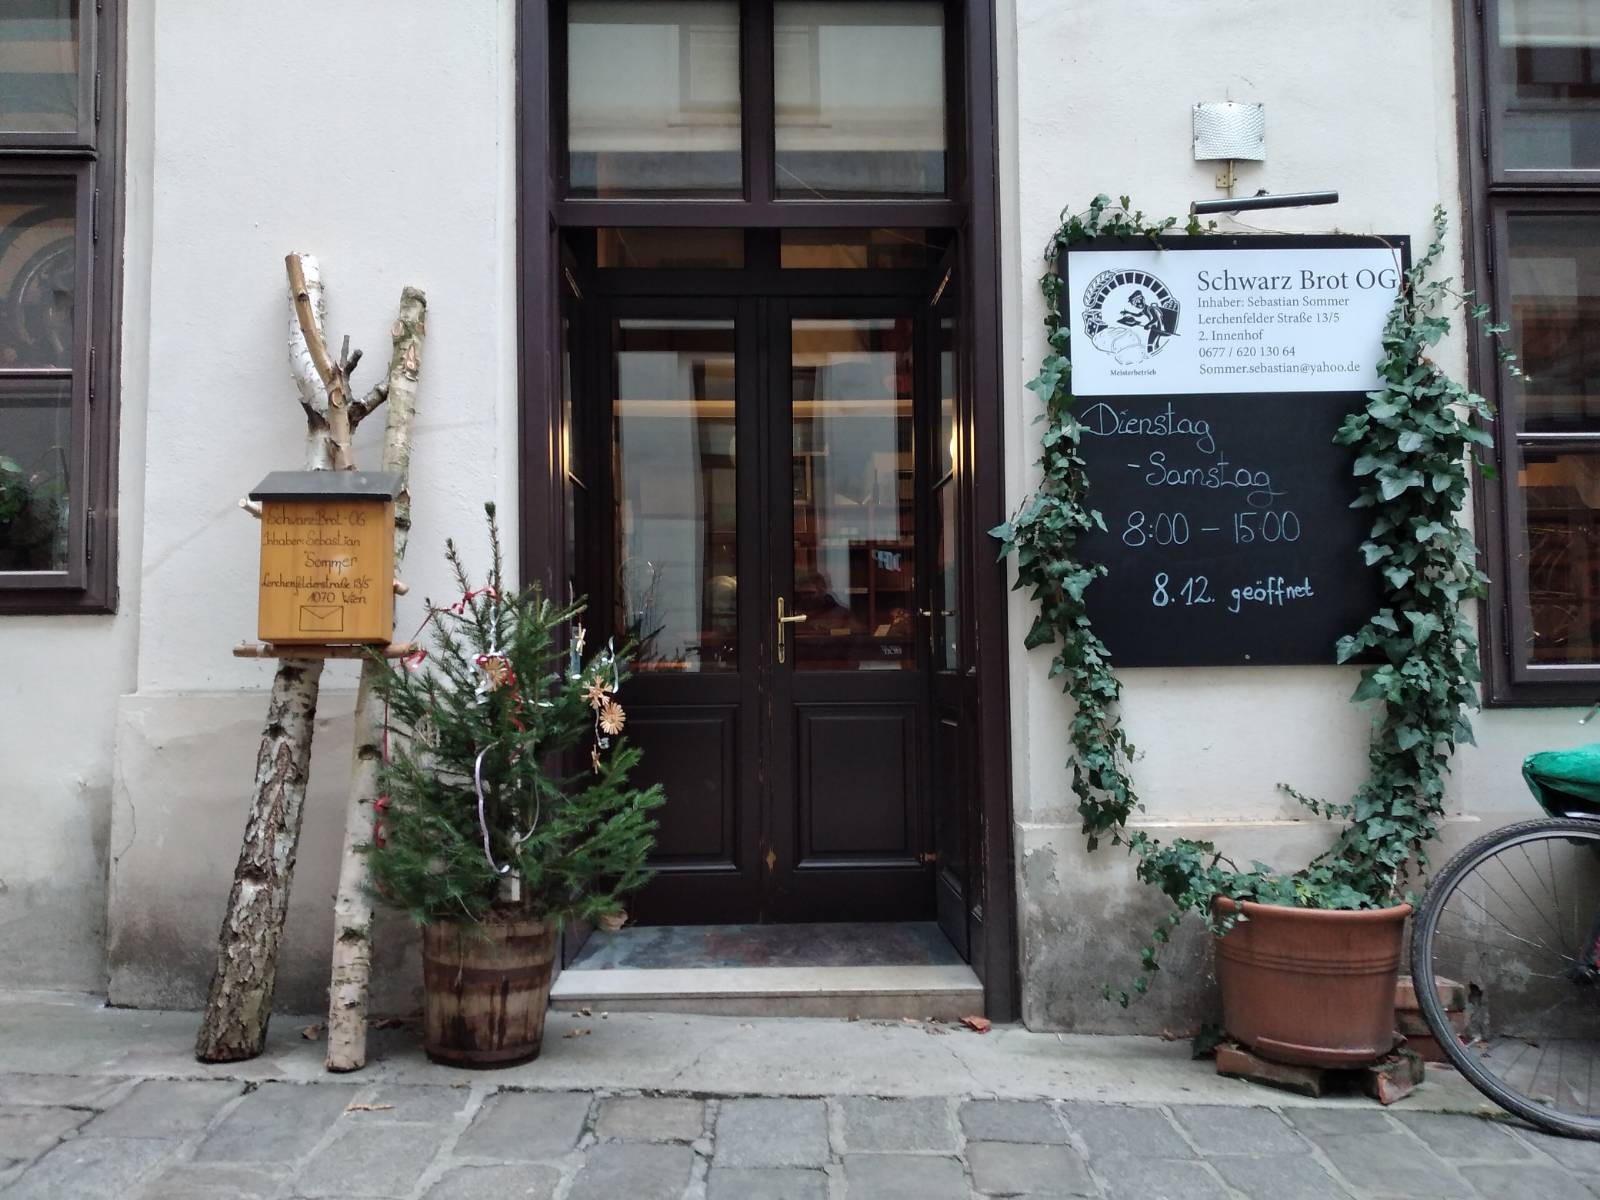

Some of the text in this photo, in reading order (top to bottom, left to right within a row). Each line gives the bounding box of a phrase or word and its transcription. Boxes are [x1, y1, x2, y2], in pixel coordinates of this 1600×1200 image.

[1197, 268, 1398, 292] Schwarz Brot OG
[1198, 295, 1350, 308] Inhaber: Sebastian Sommer
[1198, 311, 1341, 325] Lerchenfelder Straße 13/5
[1198, 328, 1265, 342] 2. Innenhof
[1198, 347, 1226, 358] 0677
[1236, 346, 1257, 357] 620
[1260, 346, 1280, 357] 130
[1282, 346, 1296, 357] 64
[1110, 368, 1157, 376] Meisterbetrieb
[1199, 360, 1361, 377] Sommer.sebastian@yahoo.de
[1080, 401, 1216, 454] Dienstag
[1145, 450, 1288, 508] Samstag
[1121, 510, 1189, 547] 8:00
[304, 550, 358, 575] Sommer
[1227, 576, 1315, 613] geöffnet
